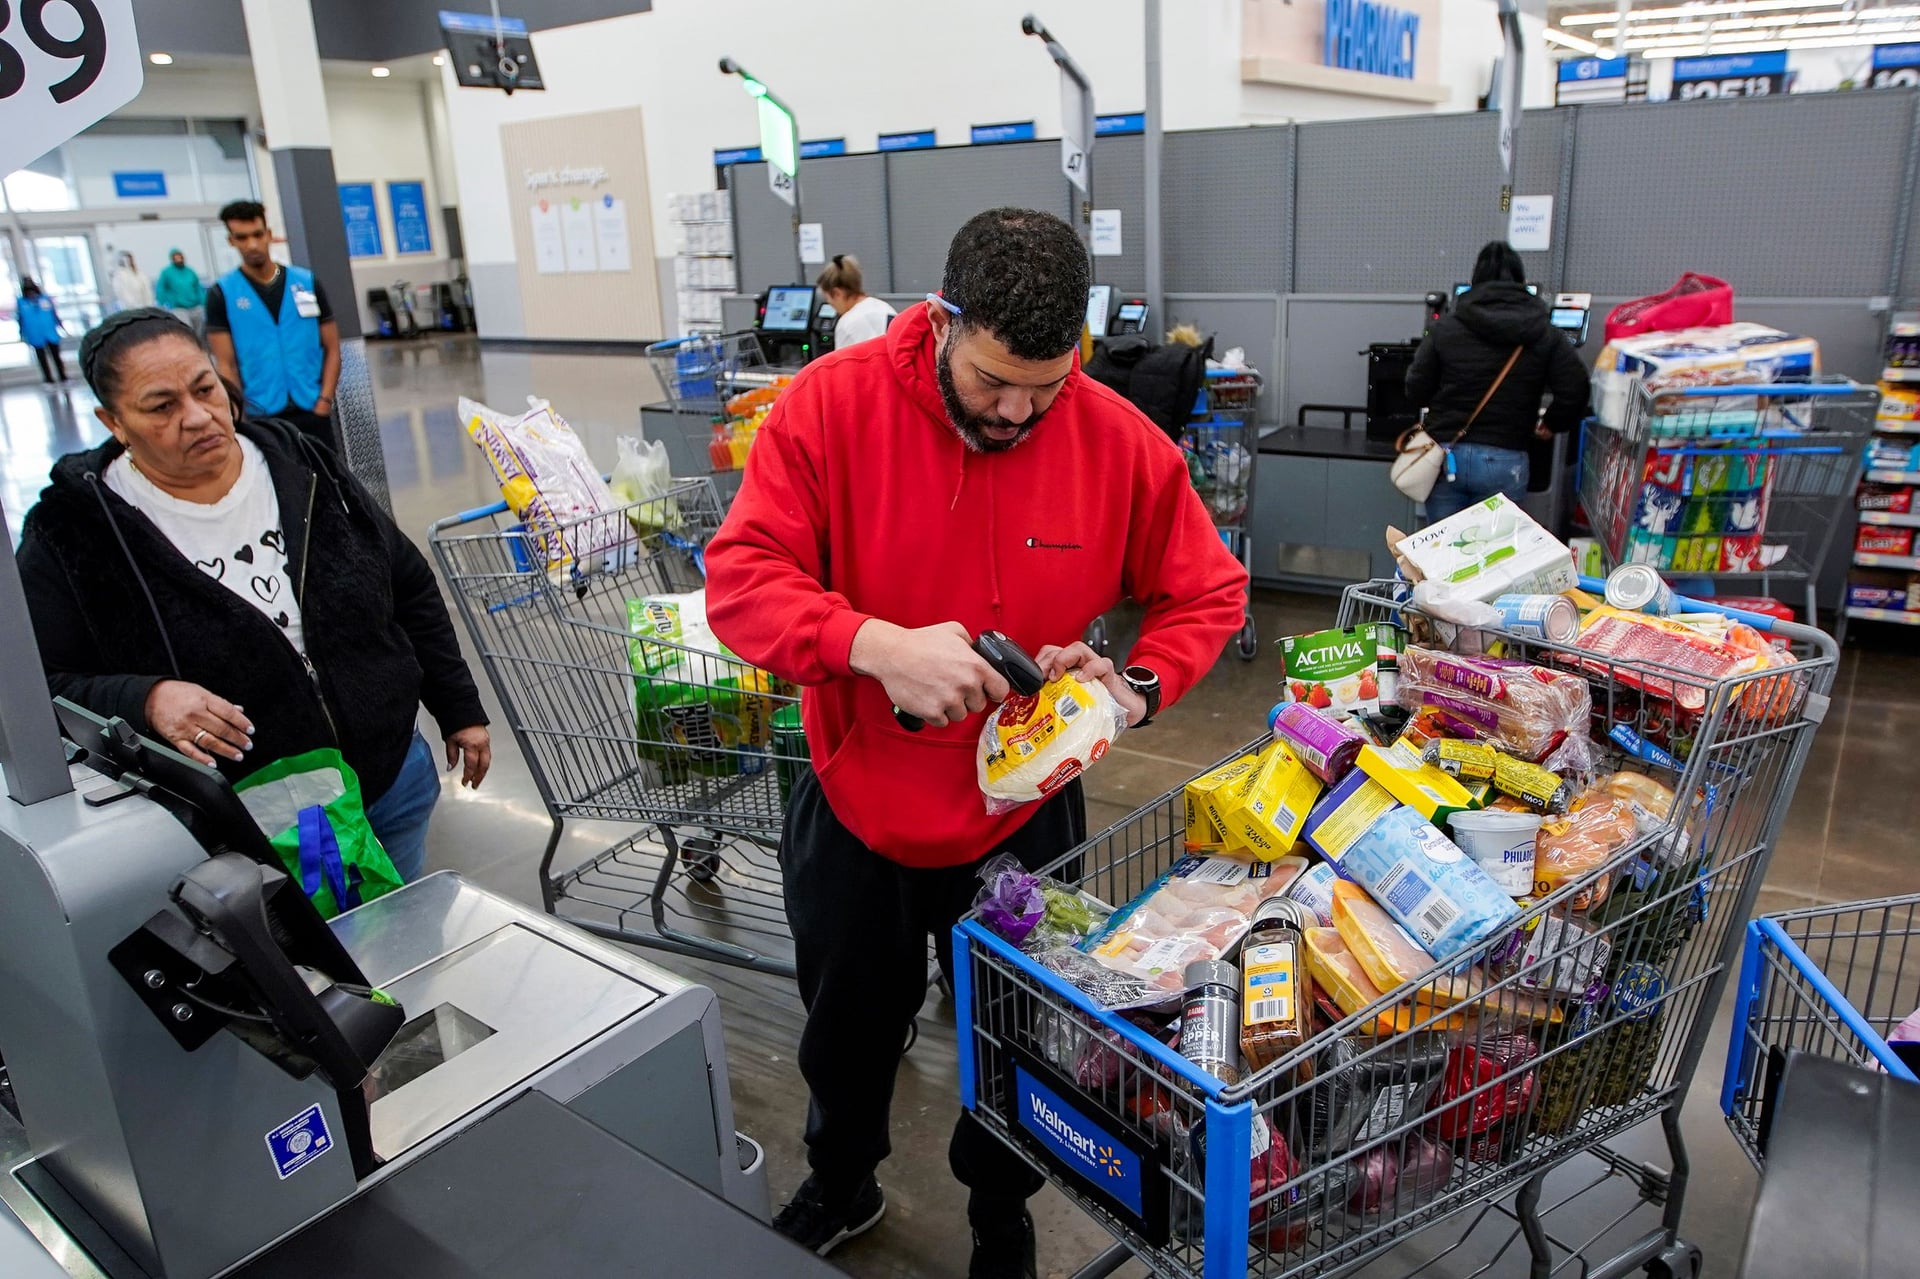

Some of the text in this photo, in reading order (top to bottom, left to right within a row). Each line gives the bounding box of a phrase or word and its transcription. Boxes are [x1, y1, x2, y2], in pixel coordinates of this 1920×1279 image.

[1026, 537, 1083, 552] Champion
[1295, 641, 1364, 667] ACTIVIA
[1183, 1031, 1220, 1044] EPPER
[1031, 1092, 1096, 1159] Walmart
[1033, 1113, 1097, 1168] Save money. Live better.
